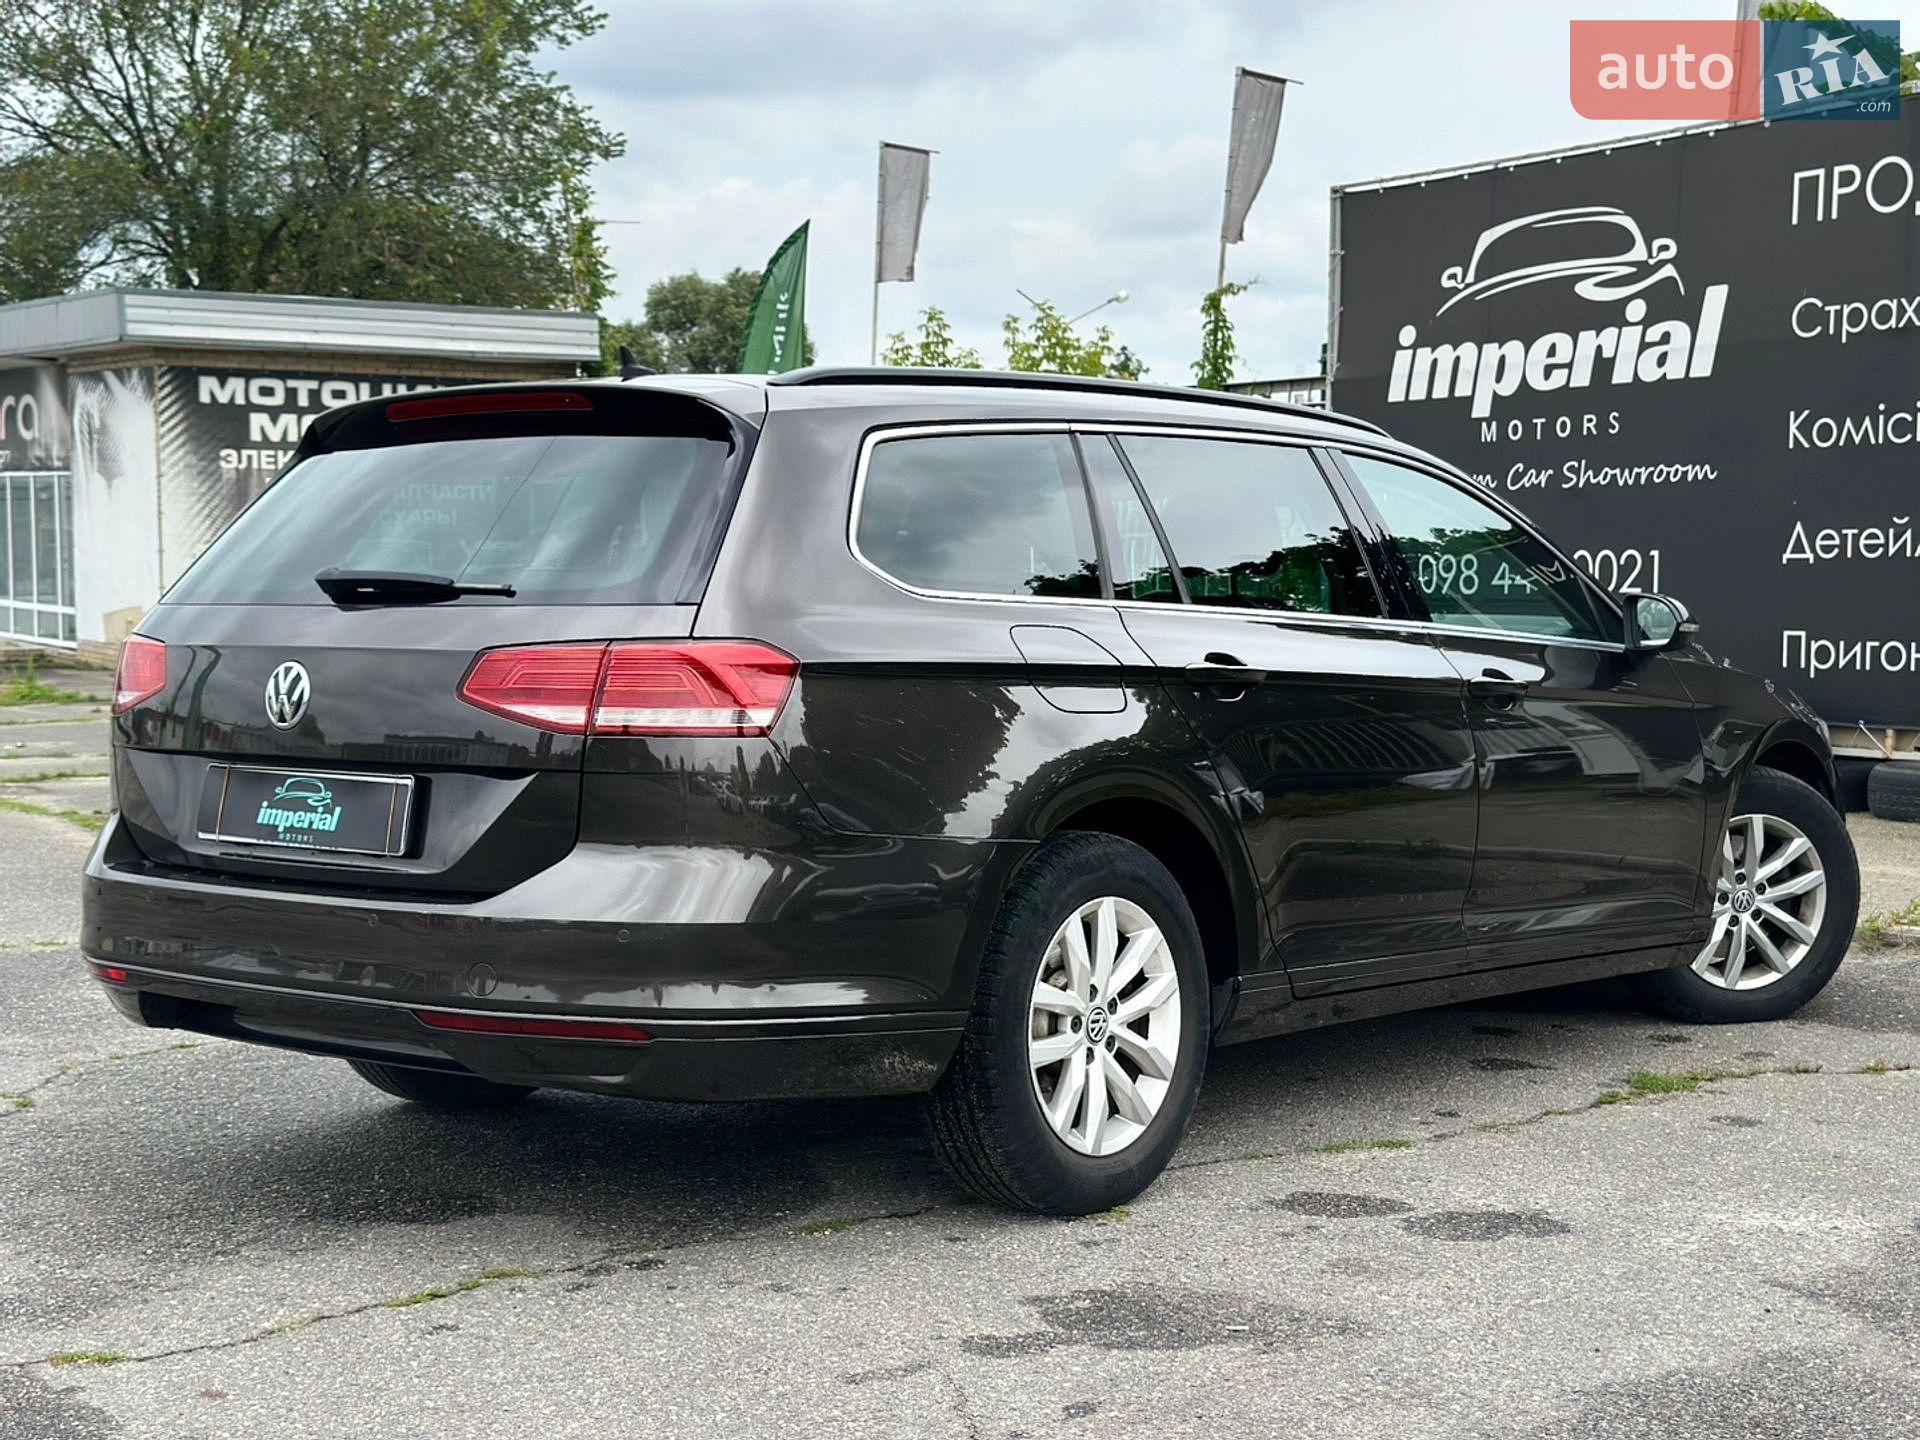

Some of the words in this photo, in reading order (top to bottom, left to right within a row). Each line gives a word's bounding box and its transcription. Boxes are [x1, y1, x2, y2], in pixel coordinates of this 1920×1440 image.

[1791, 155, 1920, 225] ПРО
[1791, 297, 1920, 343] Страх
[1388, 284, 1728, 418] imperial
[1481, 412, 1620, 442] MOTORS
[1507, 462, 1554, 491] Car
[1561, 459, 1718, 491] Showroom
[1782, 516, 1920, 564] Детей
[1418, 554, 1479, 594] 098
[256, 801, 342, 832] imperial
